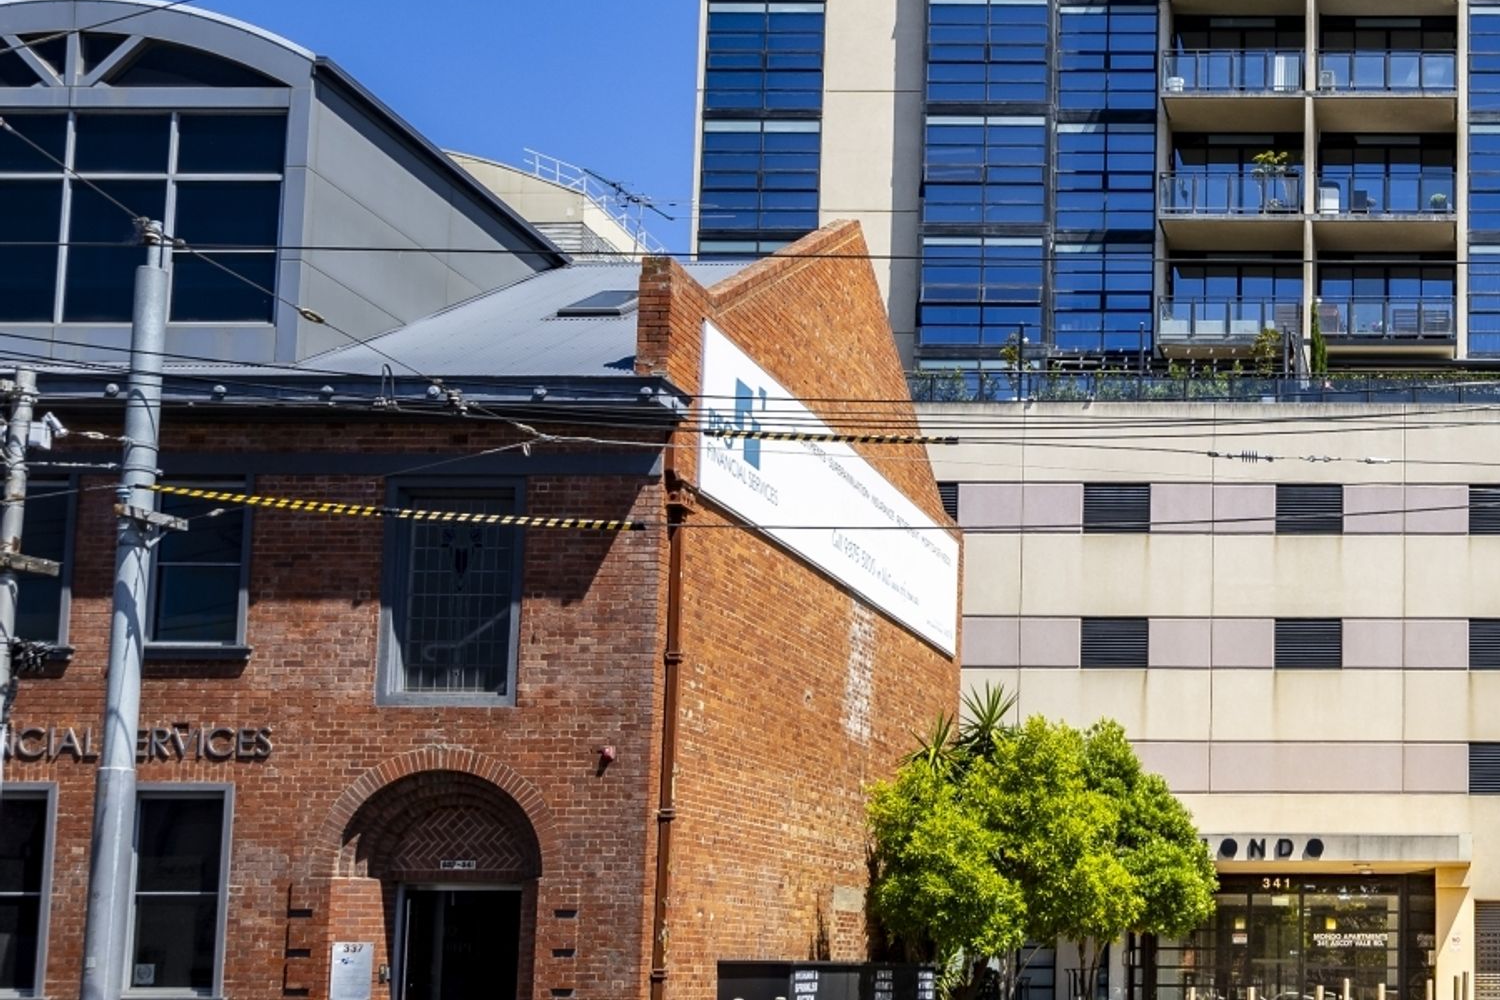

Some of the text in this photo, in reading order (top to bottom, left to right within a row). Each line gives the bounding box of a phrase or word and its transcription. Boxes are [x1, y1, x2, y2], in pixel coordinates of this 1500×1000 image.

[707, 441, 779, 506] FINANCIAL SERVICES
[136, 727, 273, 760] ERVICES
[1201, 838, 1324, 858] ONDO
[1262, 878, 1290, 889] 341
[343, 944, 363, 953] 337
